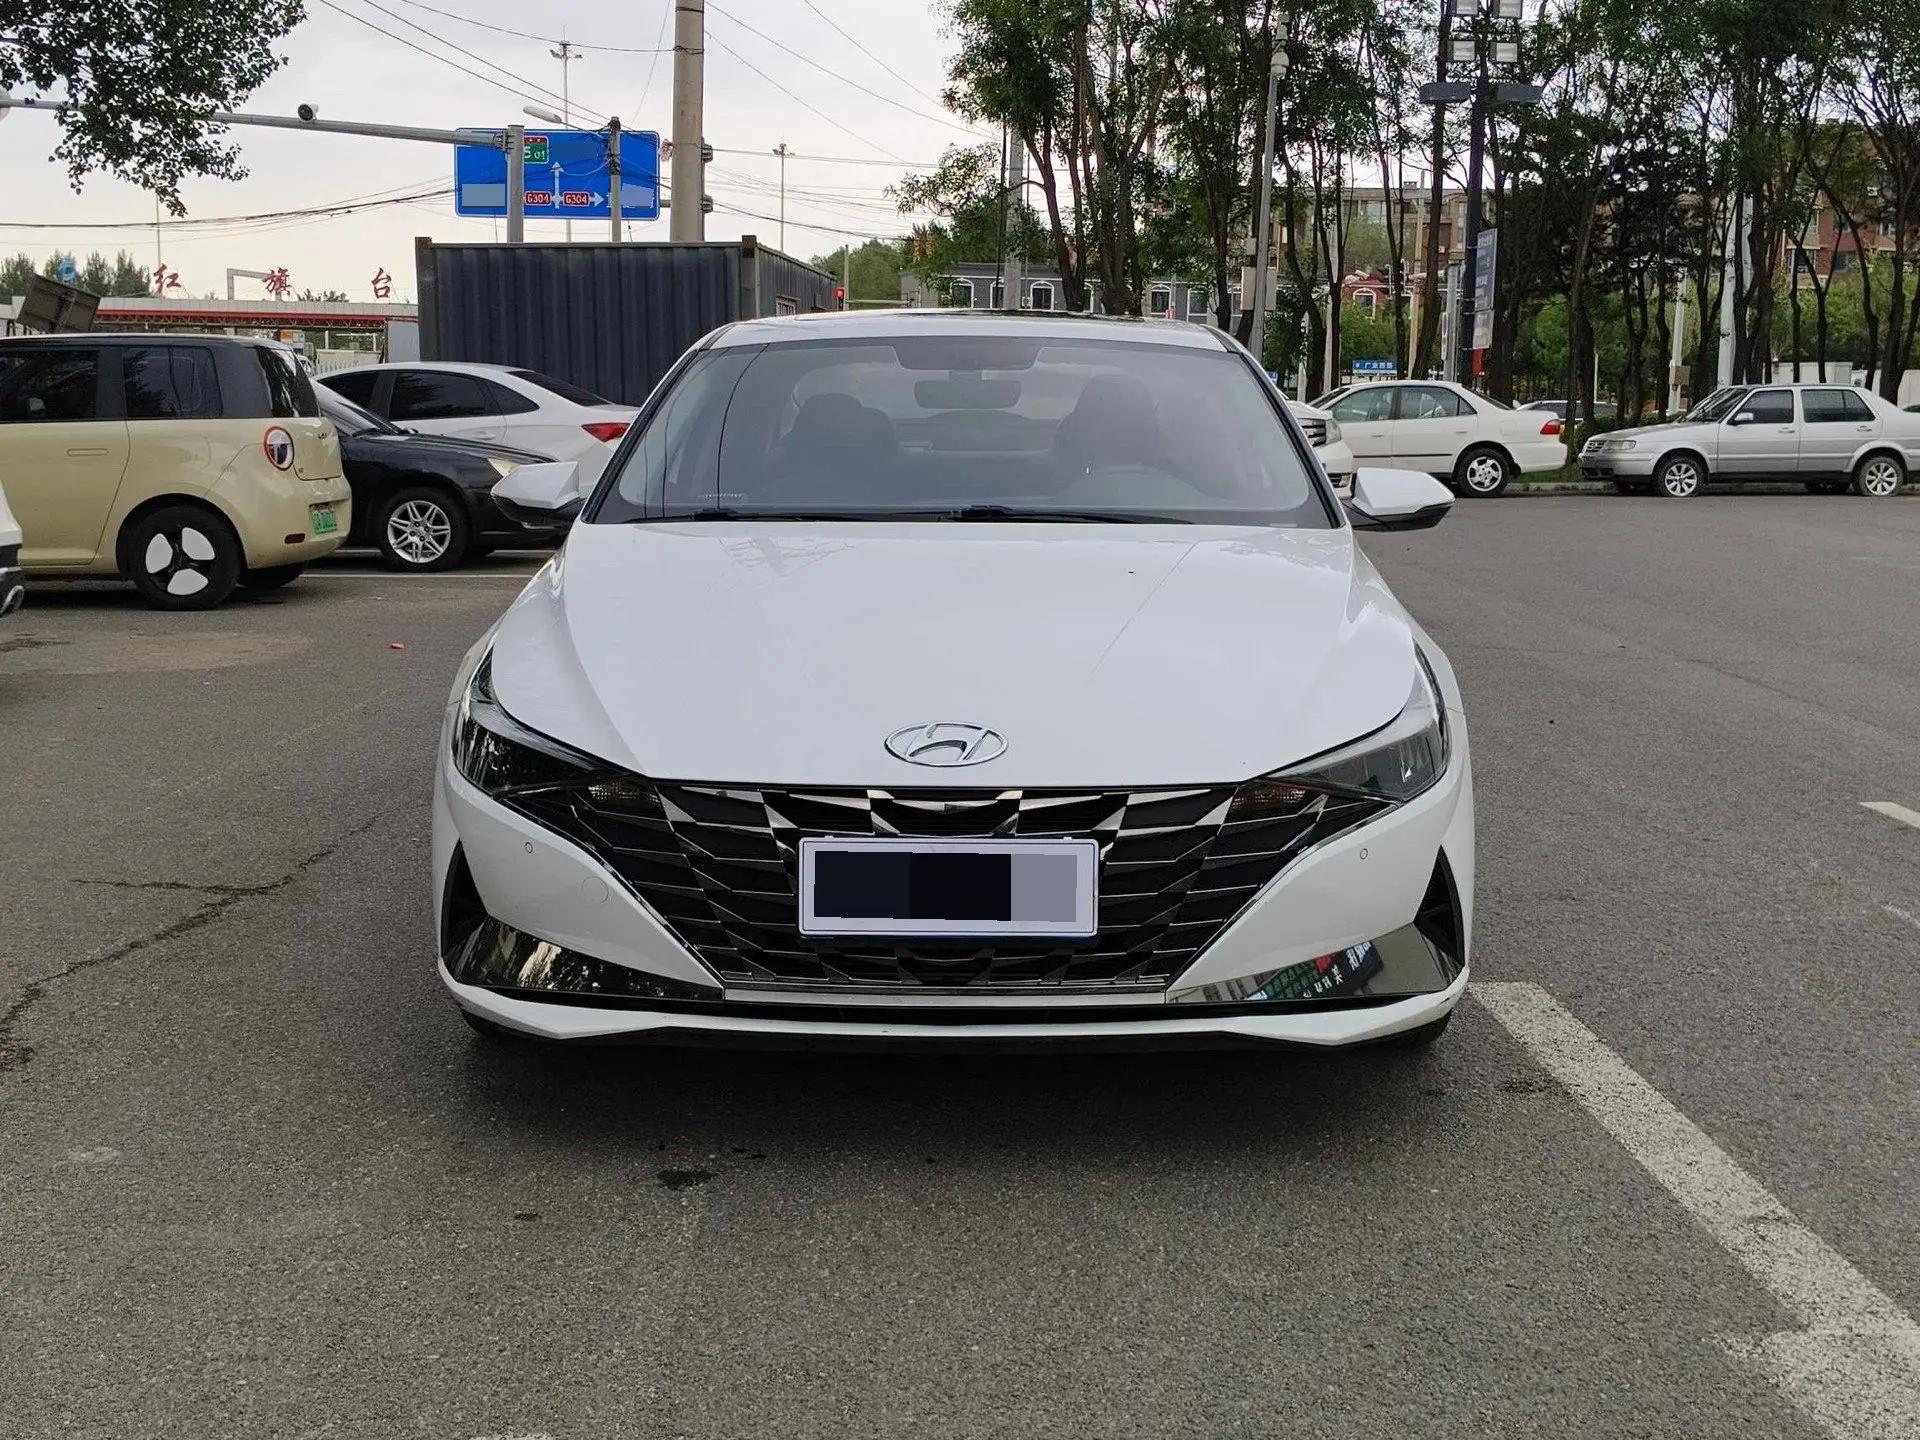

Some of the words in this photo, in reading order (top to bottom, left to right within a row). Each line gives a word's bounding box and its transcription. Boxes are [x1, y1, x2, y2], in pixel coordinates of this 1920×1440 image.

[527, 194, 549, 203] G304
[565, 194, 587, 204] G304
[153, 263, 392, 299] 红旗台
